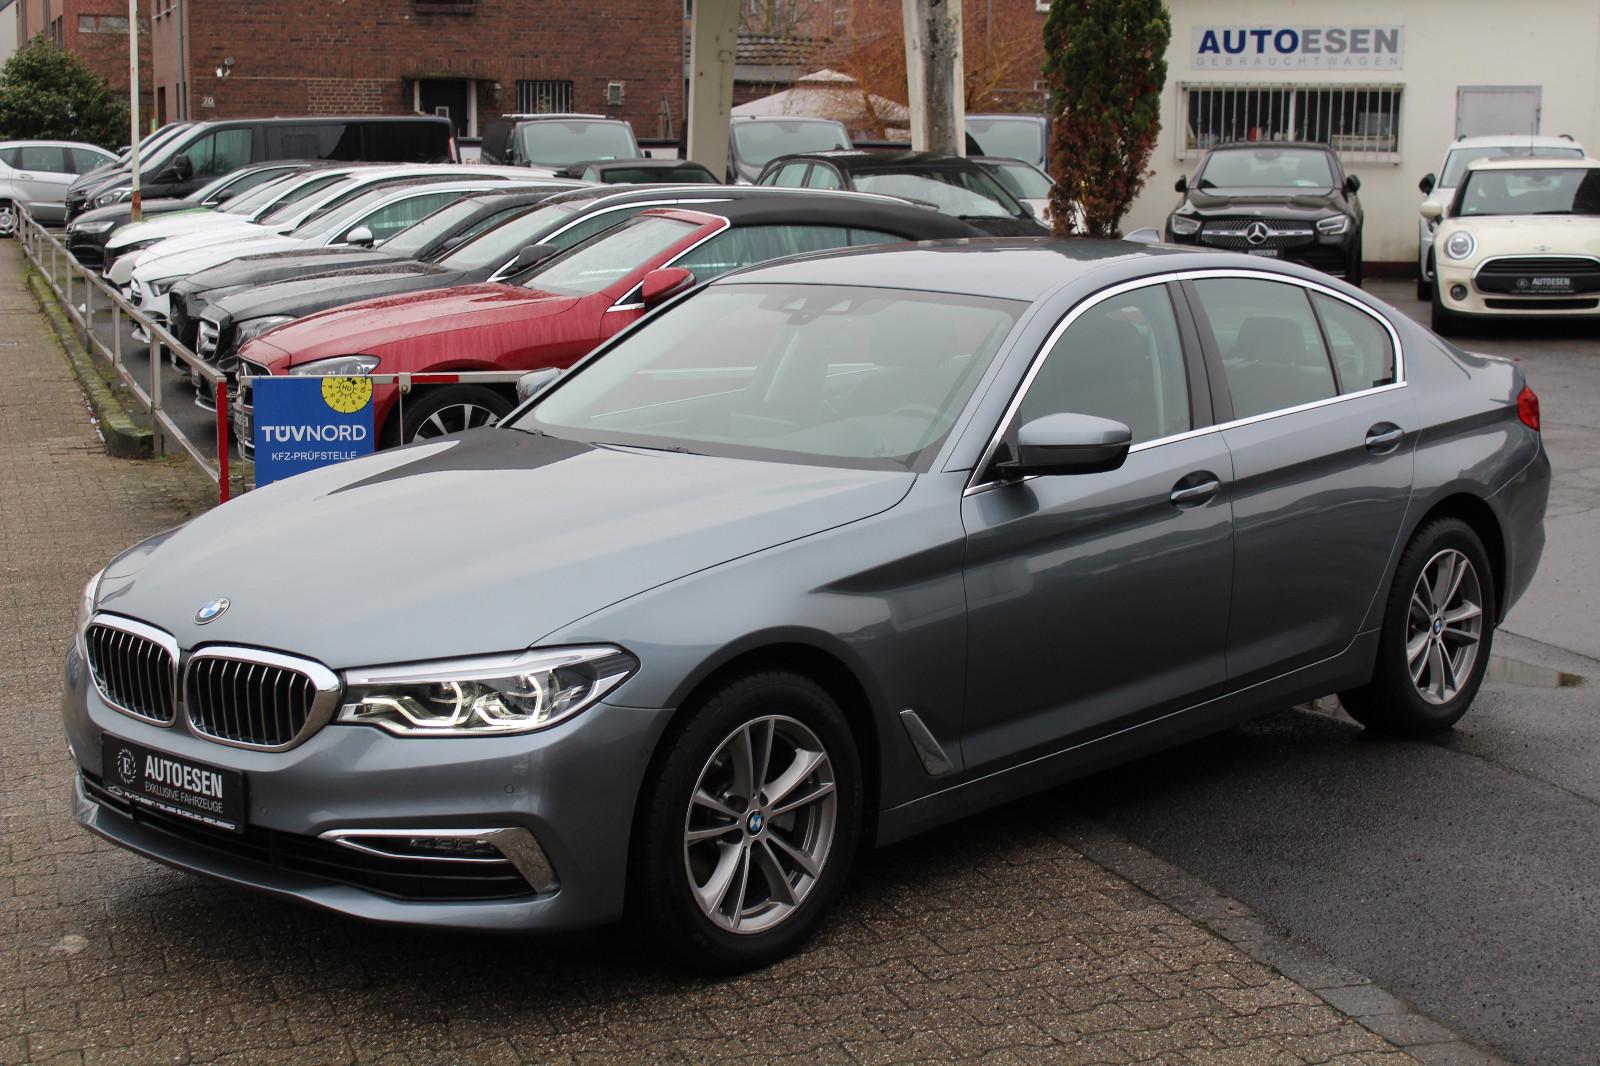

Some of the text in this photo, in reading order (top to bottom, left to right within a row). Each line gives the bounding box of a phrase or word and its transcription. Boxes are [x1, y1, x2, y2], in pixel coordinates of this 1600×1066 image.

[1196, 56, 1398, 66] GEBRAUCHTWAGEN
[202, 96, 214, 105] 70
[1531, 278, 1570, 286] AUTOESEN
[144, 754, 223, 799] AUTOESEN
[144, 780, 180, 801] EXKLUSIVE
[180, 791, 223, 814] FAHRZEUGE
